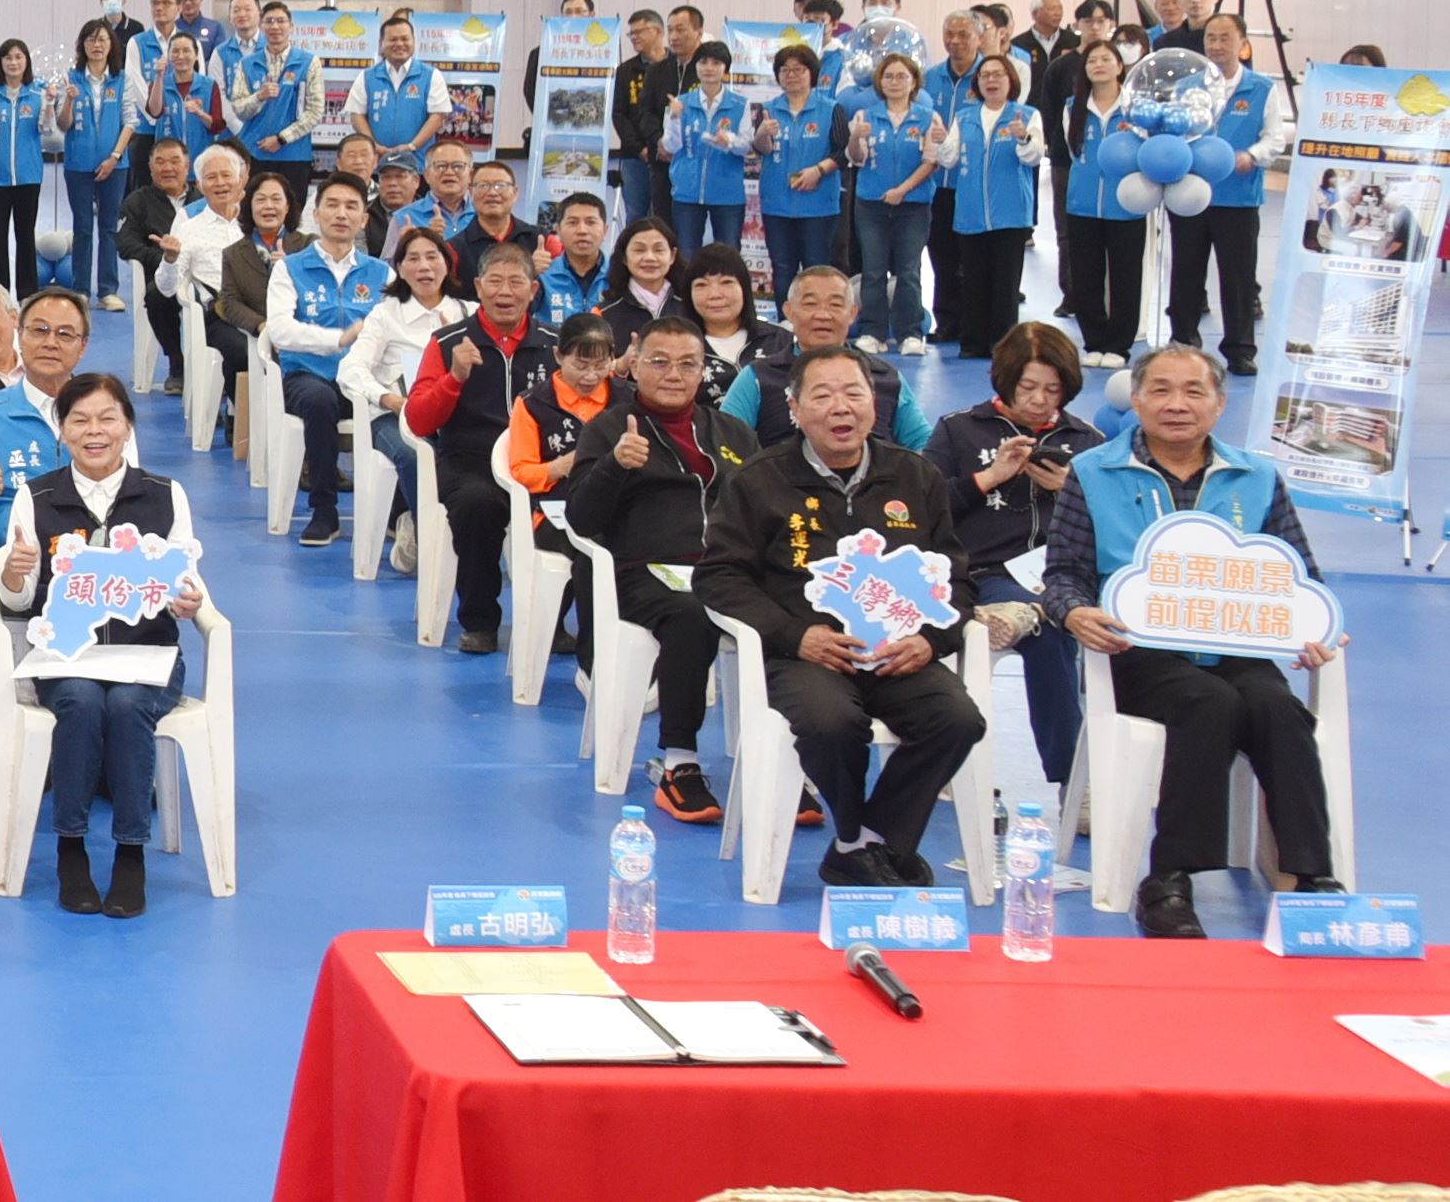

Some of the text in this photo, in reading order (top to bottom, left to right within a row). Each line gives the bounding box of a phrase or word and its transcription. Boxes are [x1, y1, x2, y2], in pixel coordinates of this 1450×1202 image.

[1324, 91, 1388, 109] 115年度
[1148, 551, 1295, 597] 苗栗願景
[65, 572, 169, 615] 頭份市
[821, 562, 924, 630] 三灣鄉
[1145, 593, 1293, 641] 前程似錦
[476, 911, 556, 937] 古明弘
[875, 914, 957, 940] 陳樹義
[1326, 920, 1411, 948] 林彥甫
